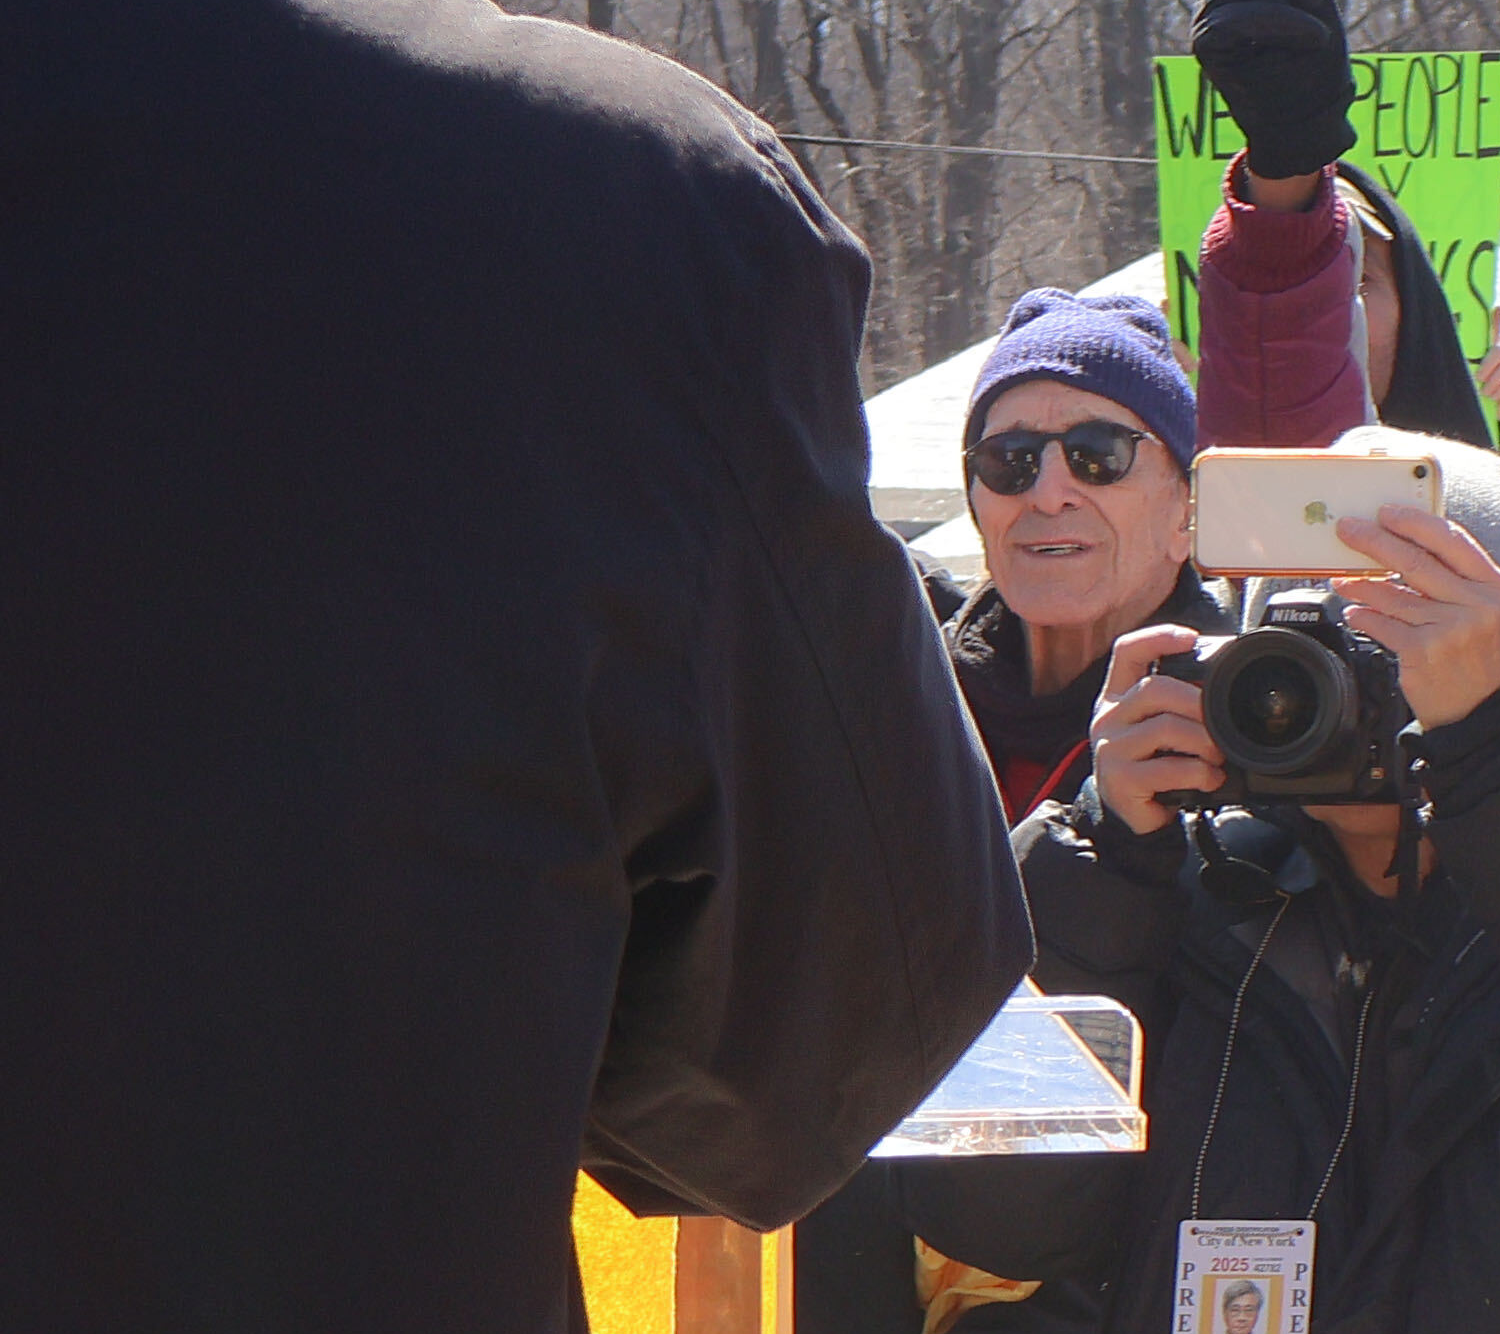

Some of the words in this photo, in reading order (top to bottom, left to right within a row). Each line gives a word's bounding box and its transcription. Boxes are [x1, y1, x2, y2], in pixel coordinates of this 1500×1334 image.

[1271, 609, 1320, 622] Nikon
[1197, 1236, 1220, 1249] City
[1224, 1235, 1236, 1247] of
[1237, 1235, 1262, 1247] New
[1264, 1235, 1296, 1247] York
[1211, 1257, 1250, 1272] 2025
